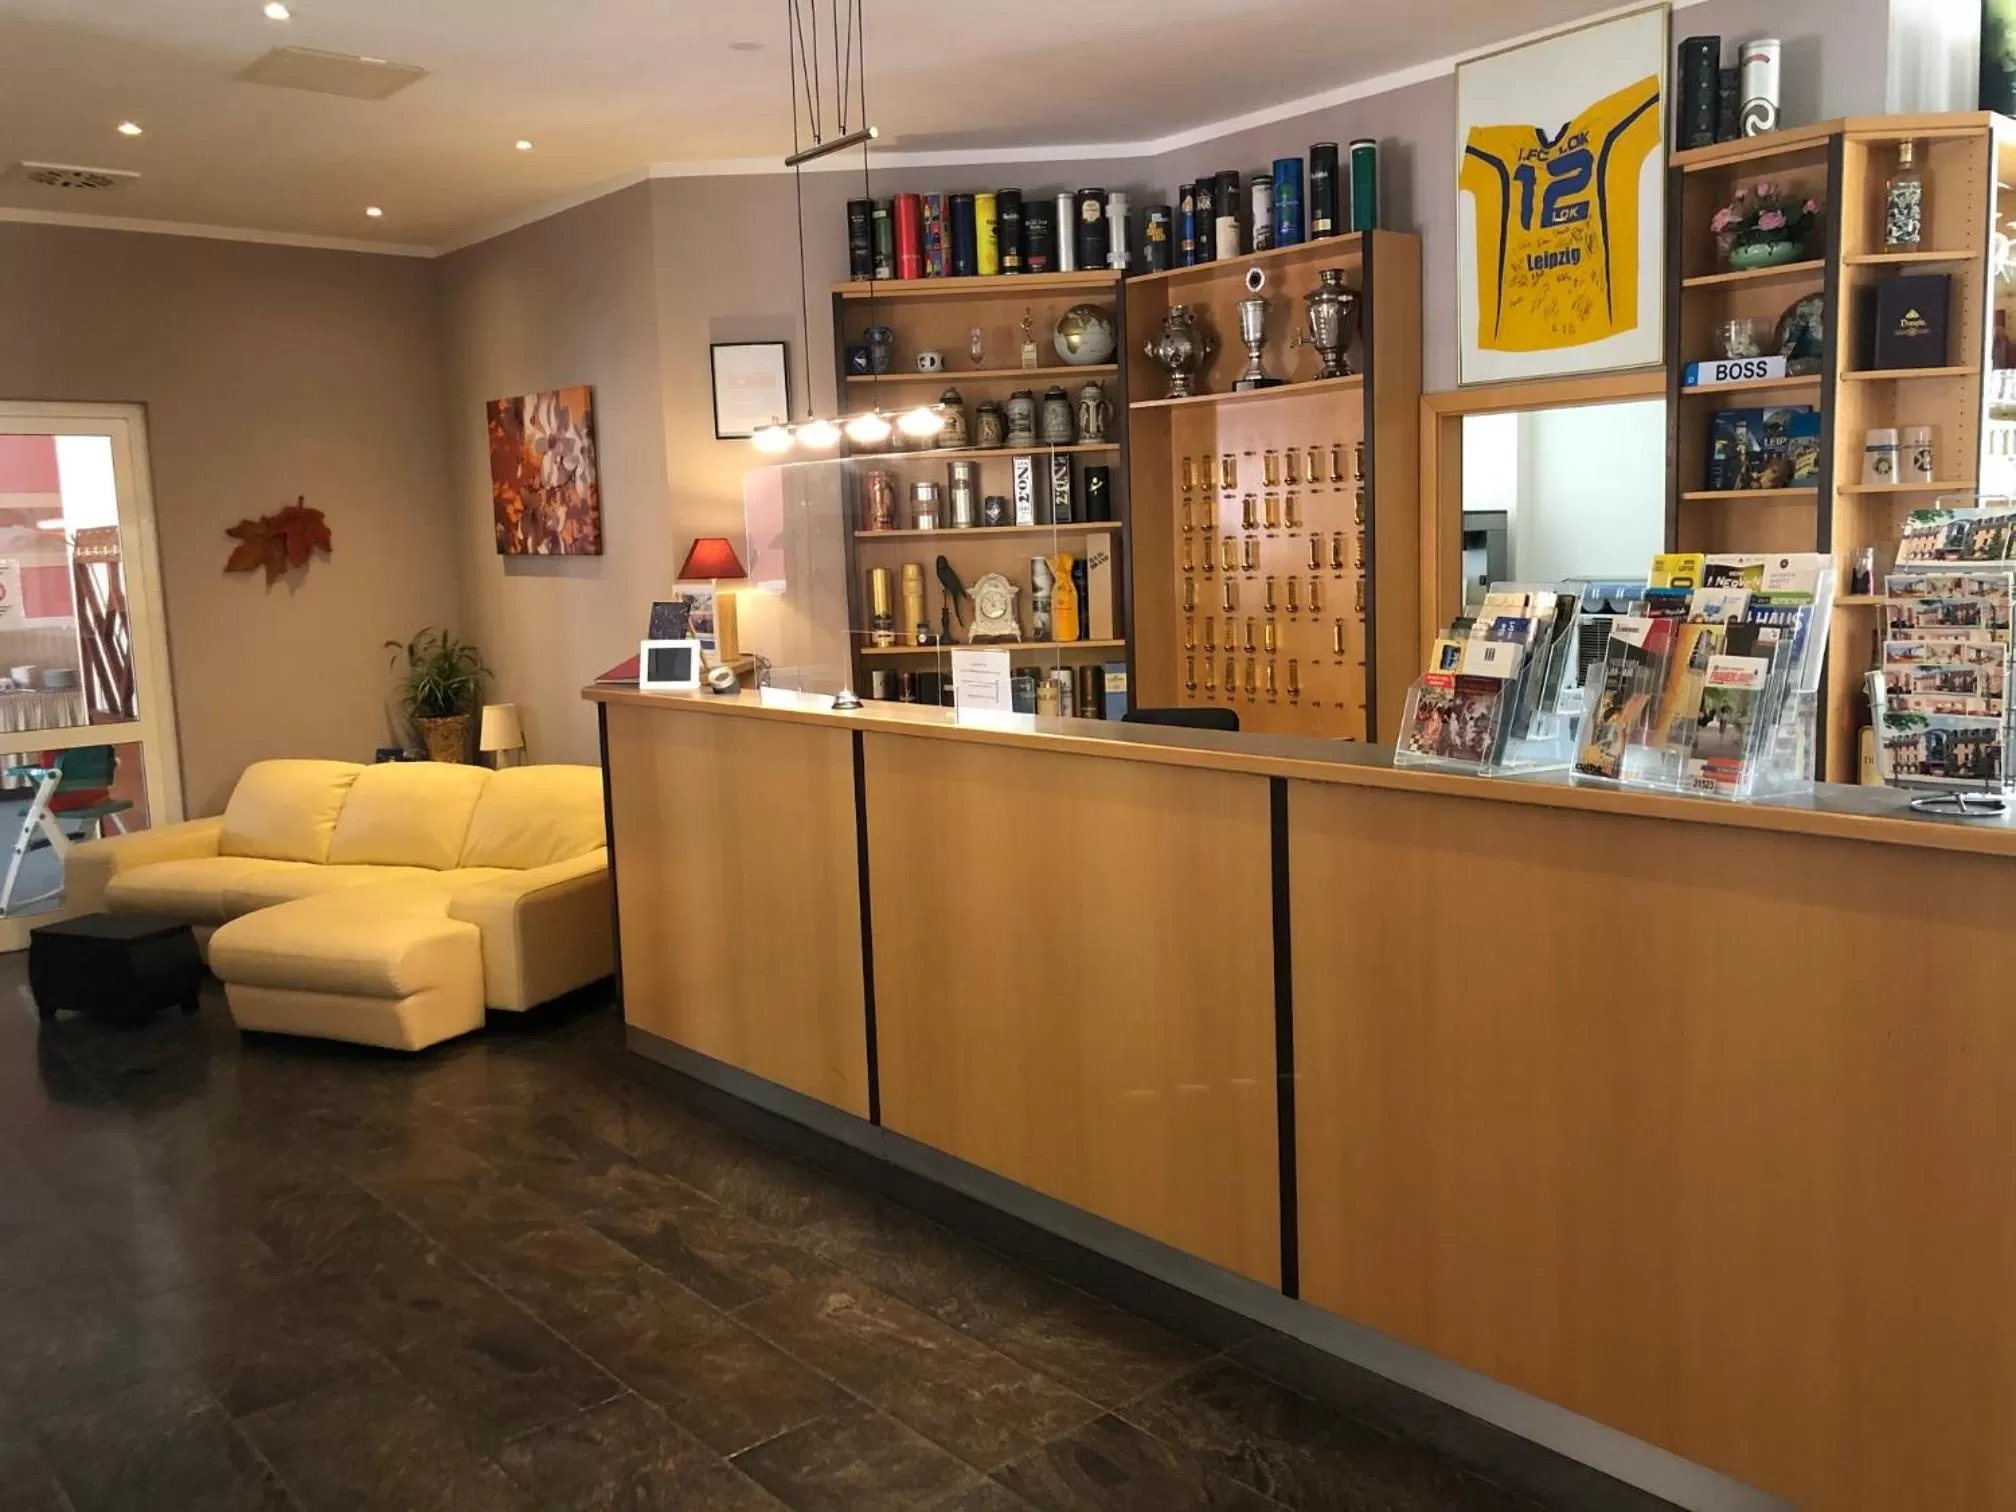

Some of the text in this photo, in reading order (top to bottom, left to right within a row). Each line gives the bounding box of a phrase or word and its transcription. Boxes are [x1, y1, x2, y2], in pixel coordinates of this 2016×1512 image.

[1558, 130, 1590, 156] LOK
[1513, 148, 1594, 231] 12
[1551, 206, 1579, 222] LOK
[1526, 246, 1581, 271] Leipzig
[1715, 360, 1768, 381] BOSS
